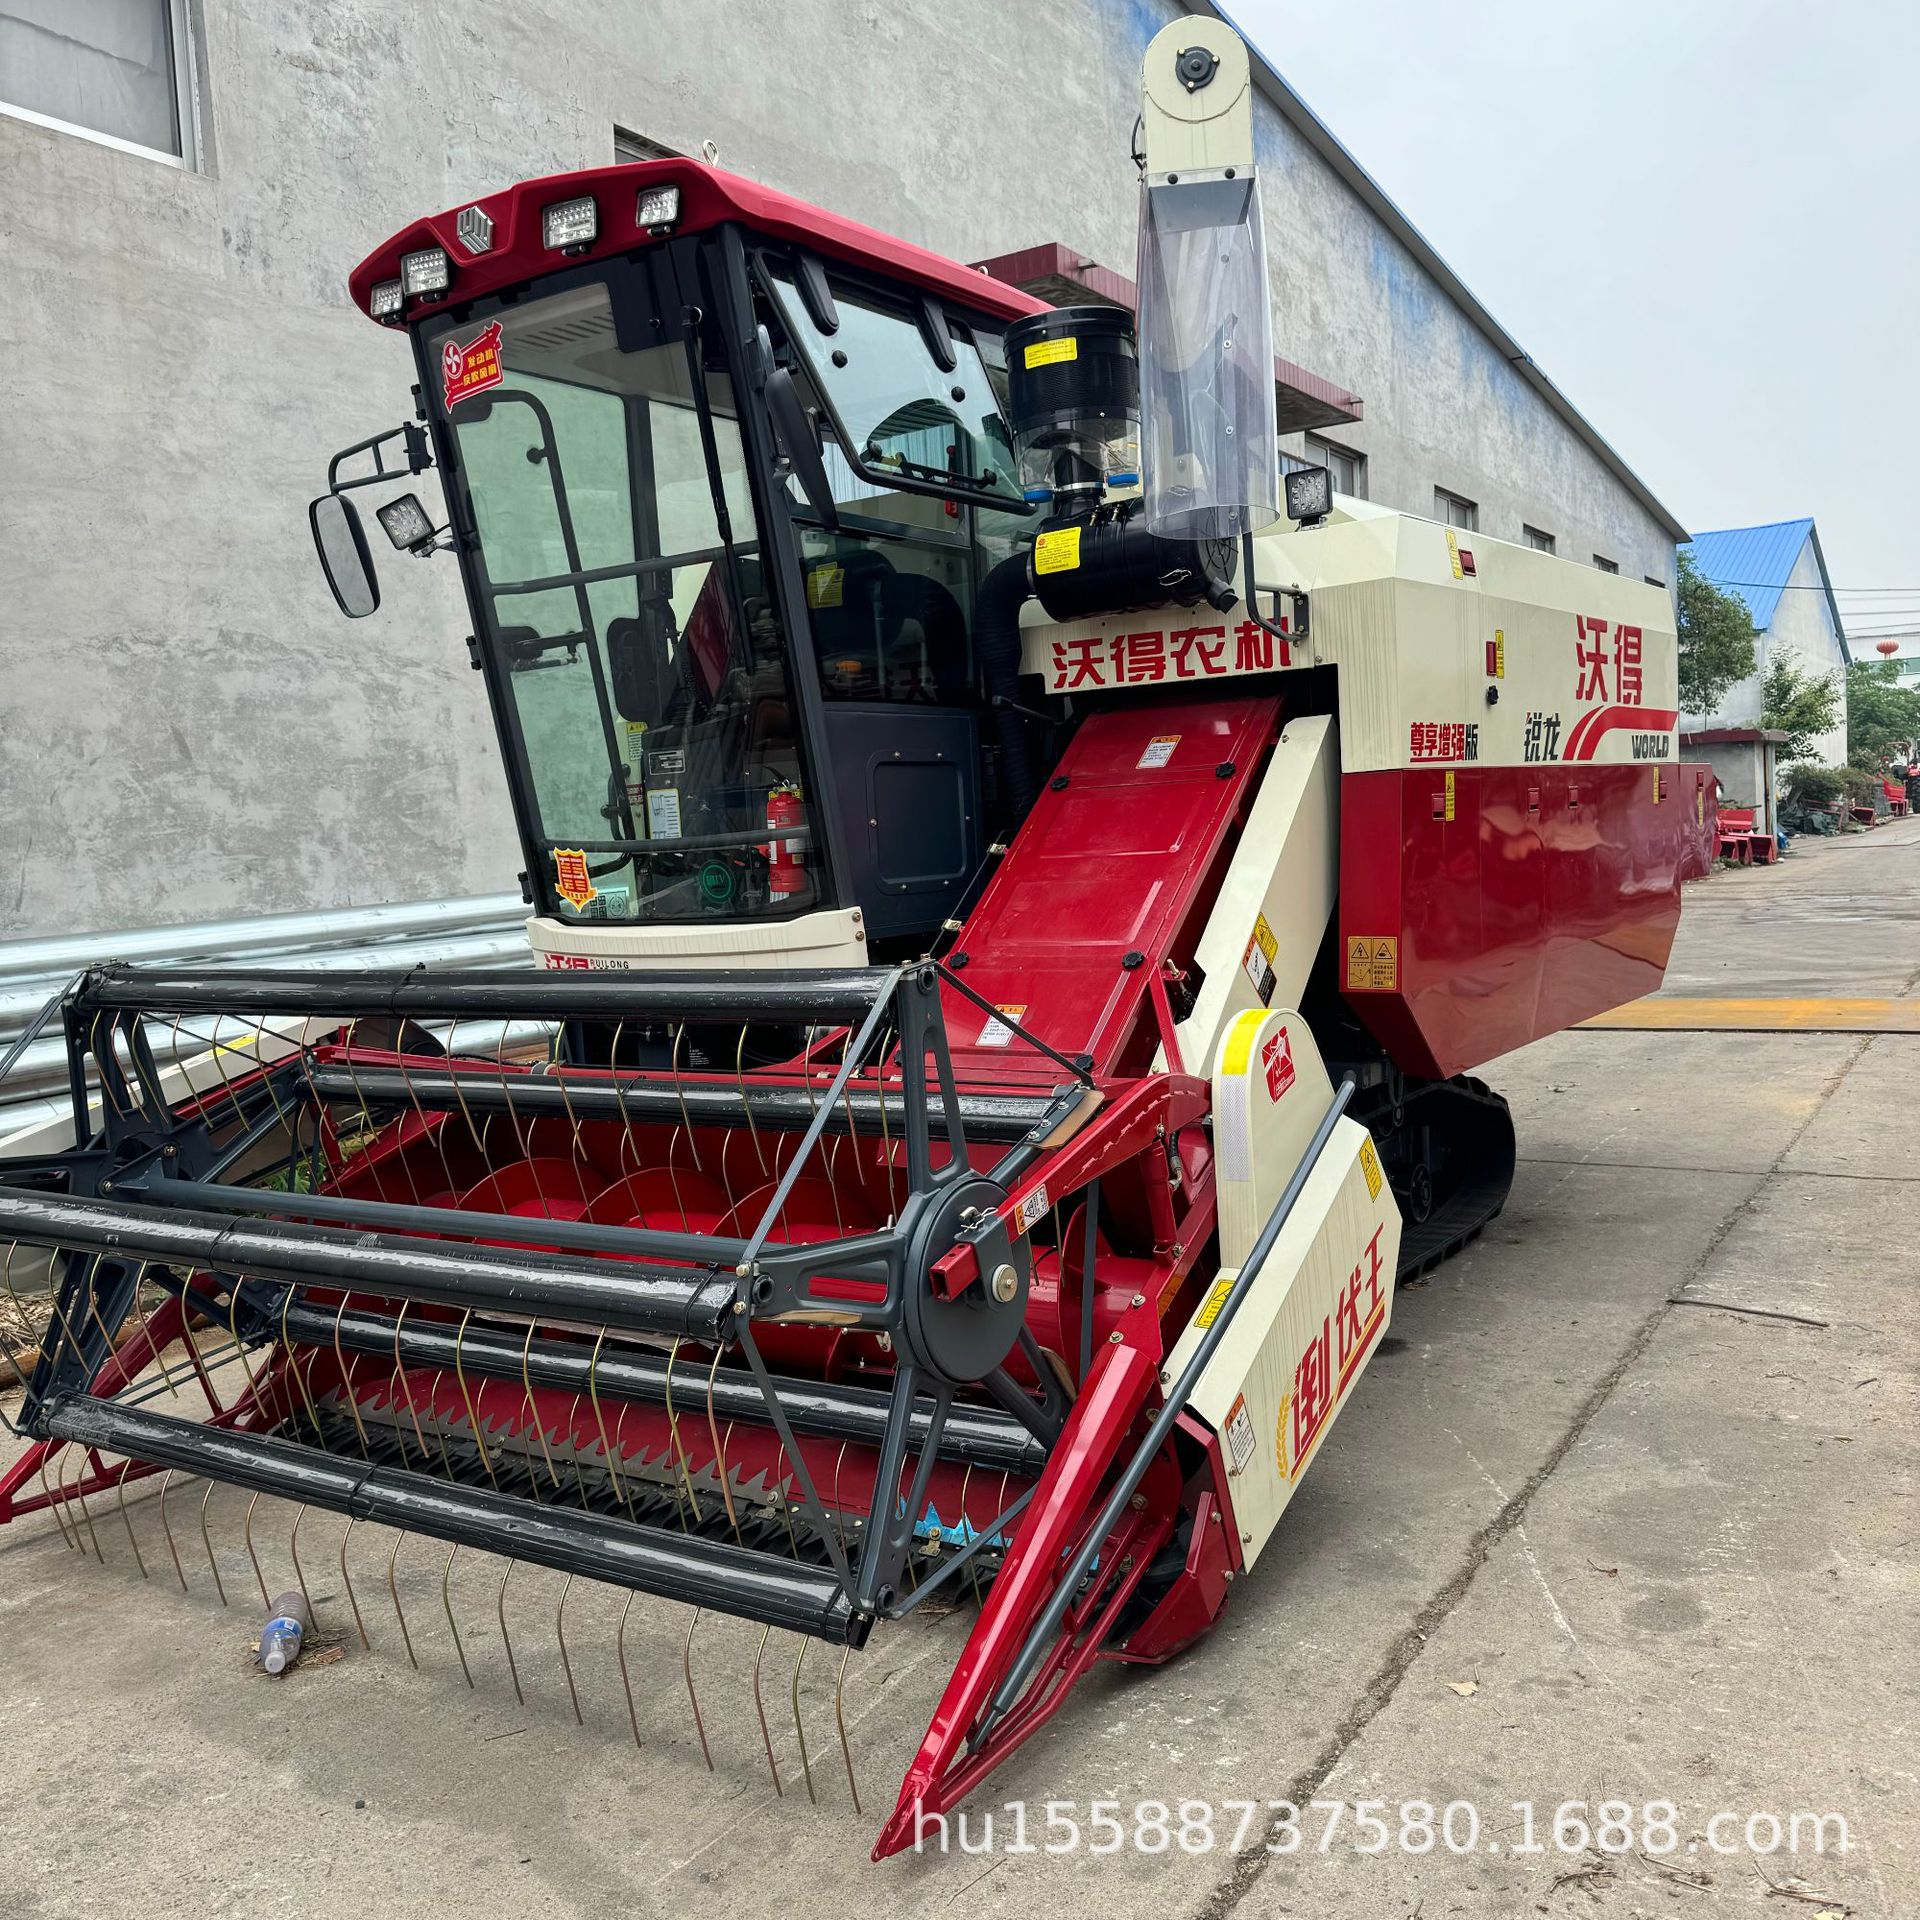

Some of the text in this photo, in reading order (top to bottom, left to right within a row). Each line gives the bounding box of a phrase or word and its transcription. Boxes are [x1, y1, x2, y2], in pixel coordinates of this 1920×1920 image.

[467, 348, 494, 368] 发动机
[1051, 615, 1292, 690] 沃得农机
[1576, 614, 1643, 706] 沃得
[1410, 722, 1479, 762] 尊享增强版
[1524, 712, 1561, 762] 锐龙
[1631, 734, 1670, 759] WORLD
[590, 959, 630, 969] RUILONG
